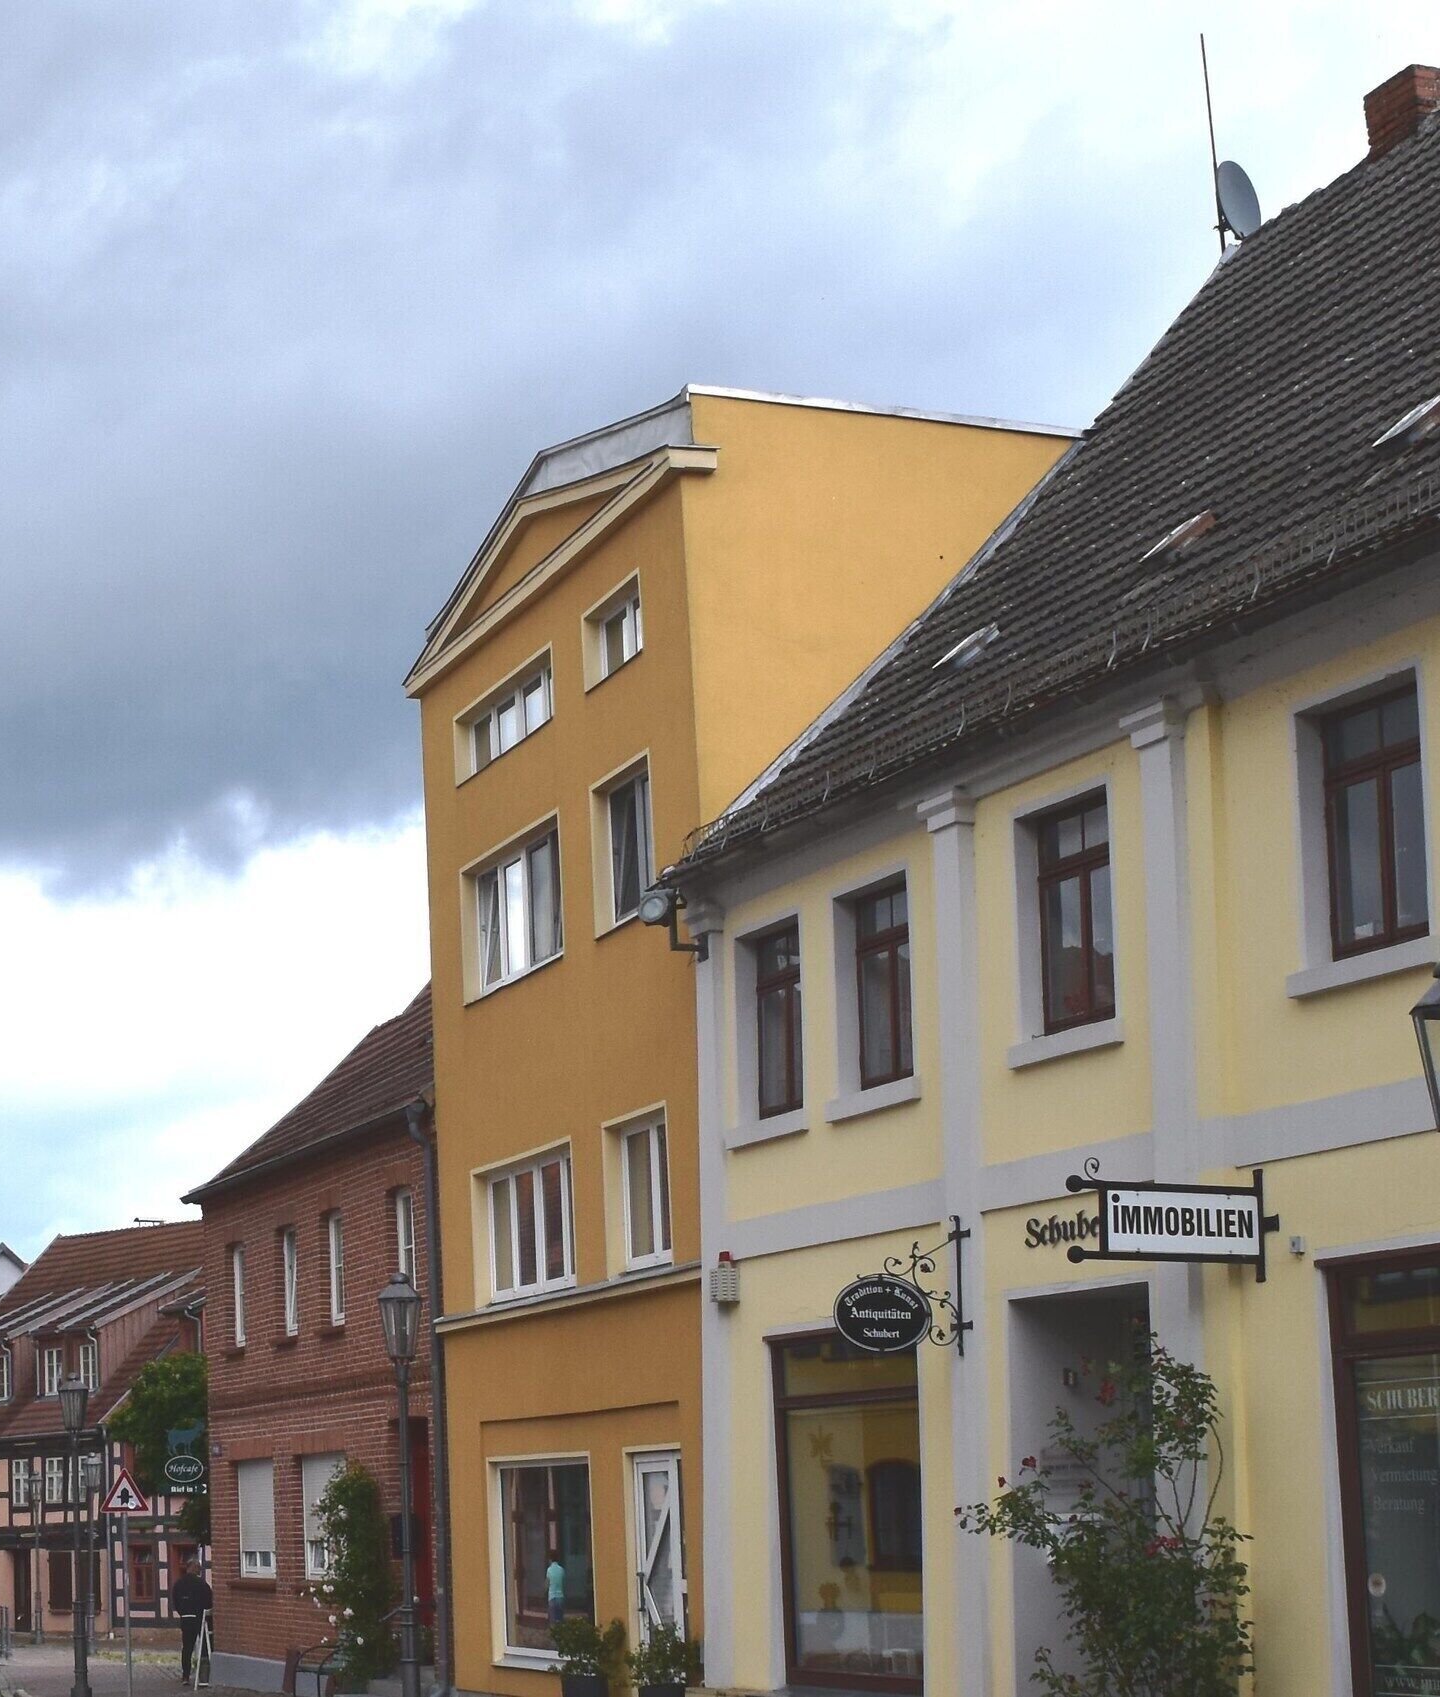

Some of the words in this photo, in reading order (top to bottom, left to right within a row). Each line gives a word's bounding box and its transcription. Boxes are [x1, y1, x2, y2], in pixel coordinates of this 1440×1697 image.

[844, 1285, 884, 1307] Tradition
[850, 1306, 912, 1321] Antiquitäten
[863, 1327, 901, 1339] Schubert
